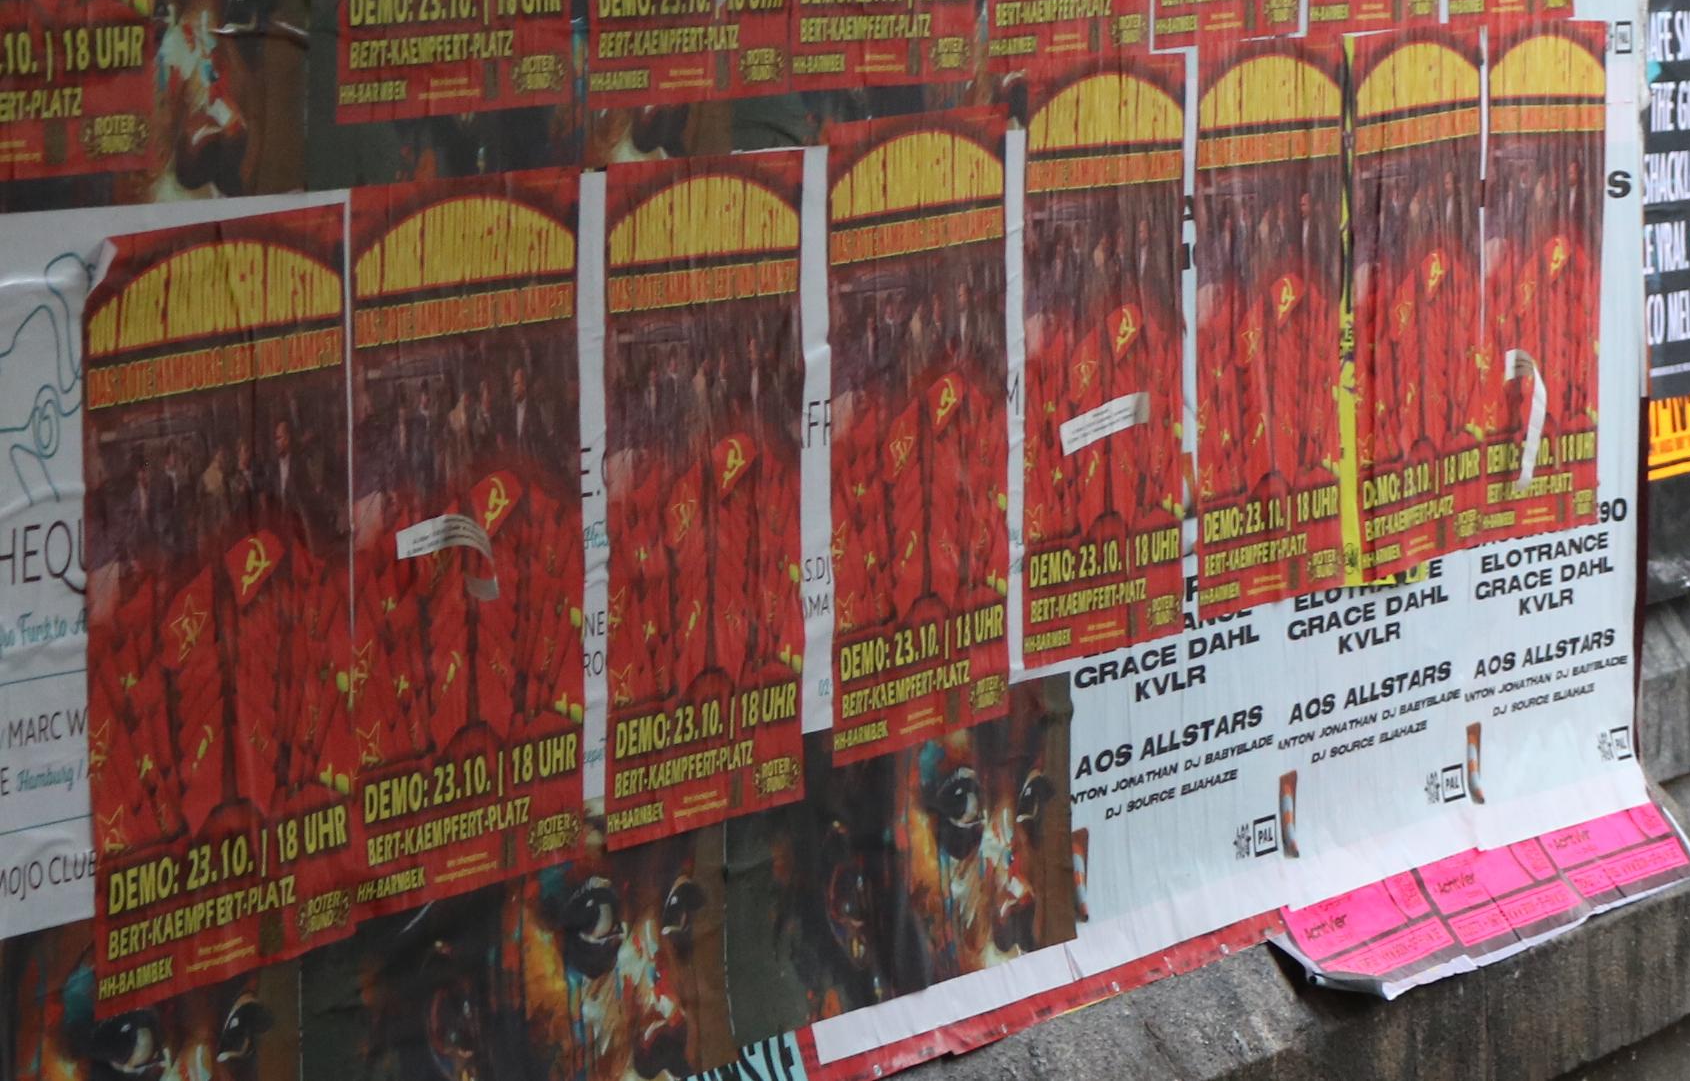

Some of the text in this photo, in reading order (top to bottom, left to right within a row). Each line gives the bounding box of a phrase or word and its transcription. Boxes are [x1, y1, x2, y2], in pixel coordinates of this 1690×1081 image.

[64, 26, 145, 71] 18 UHR
[350, 30, 515, 69] BERT-KAEMPFERT-PLATZ
[599, 24, 740, 59] BERT-KAEMPFERT-PLATZ
[1650, 82, 1676, 132] THE
[1203, 485, 1338, 544] DEMO: 18 UHR
[1029, 528, 1180, 589] DEMO: 23.10. 18 UHR
[1481, 531, 1609, 574] ELOTRANCE
[1475, 556, 1614, 601] GRACE DAHL
[1287, 585, 1448, 641] GRACE DAHL
[1518, 588, 1574, 616] KVLR
[840, 604, 1004, 682] DEMO: 23.10. 18 UHR
[1074, 624, 1260, 689] GRACE DAHL
[1338, 621, 1401, 655] KVLR
[1473, 628, 1616, 679] AOS ALLSTARS
[841, 659, 971, 719] BERT-KAEMPFERT-PLATZ
[1135, 664, 1206, 702] KVLR
[1288, 661, 1452, 725] AOS ALLSTARS
[1556, 667, 1569, 680] DJ
[615, 682, 797, 760] DEMO: 23.10. 18 UHR
[1319, 712, 1378, 738] JONATHAN
[1382, 706, 1398, 721] DJ
[1492, 693, 1550, 717] DJ SOURCE
[8, 711, 62, 749] MARC
[1074, 704, 1264, 780] AOS ALLSTARS
[1311, 749, 1326, 764] DJ
[1330, 735, 1375, 759] SOURCE
[364, 732, 578, 824] DEMO: 23.10. 18 UHR
[614, 740, 754, 799] BERT-KAEMPFERT-PLATZ
[1112, 734, 1274, 794] JONATHAN DJ BABYBLADE
[1105, 802, 1122, 820] DJ
[1127, 787, 1176, 814] SOURCE
[367, 796, 531, 867] BERT-KAEMPFERT-PLATZ
[1257, 826, 1274, 844] PAL
[109, 804, 347, 915] DEMO: 23.10. 18 UHR
[307, 890, 342, 916] ROTER
[356, 867, 426, 904] HH-BARMBEK
[107, 875, 296, 961] BERT-KAEMPFERT-PLATZ
[99, 956, 174, 1000] HH-BARMBEK
